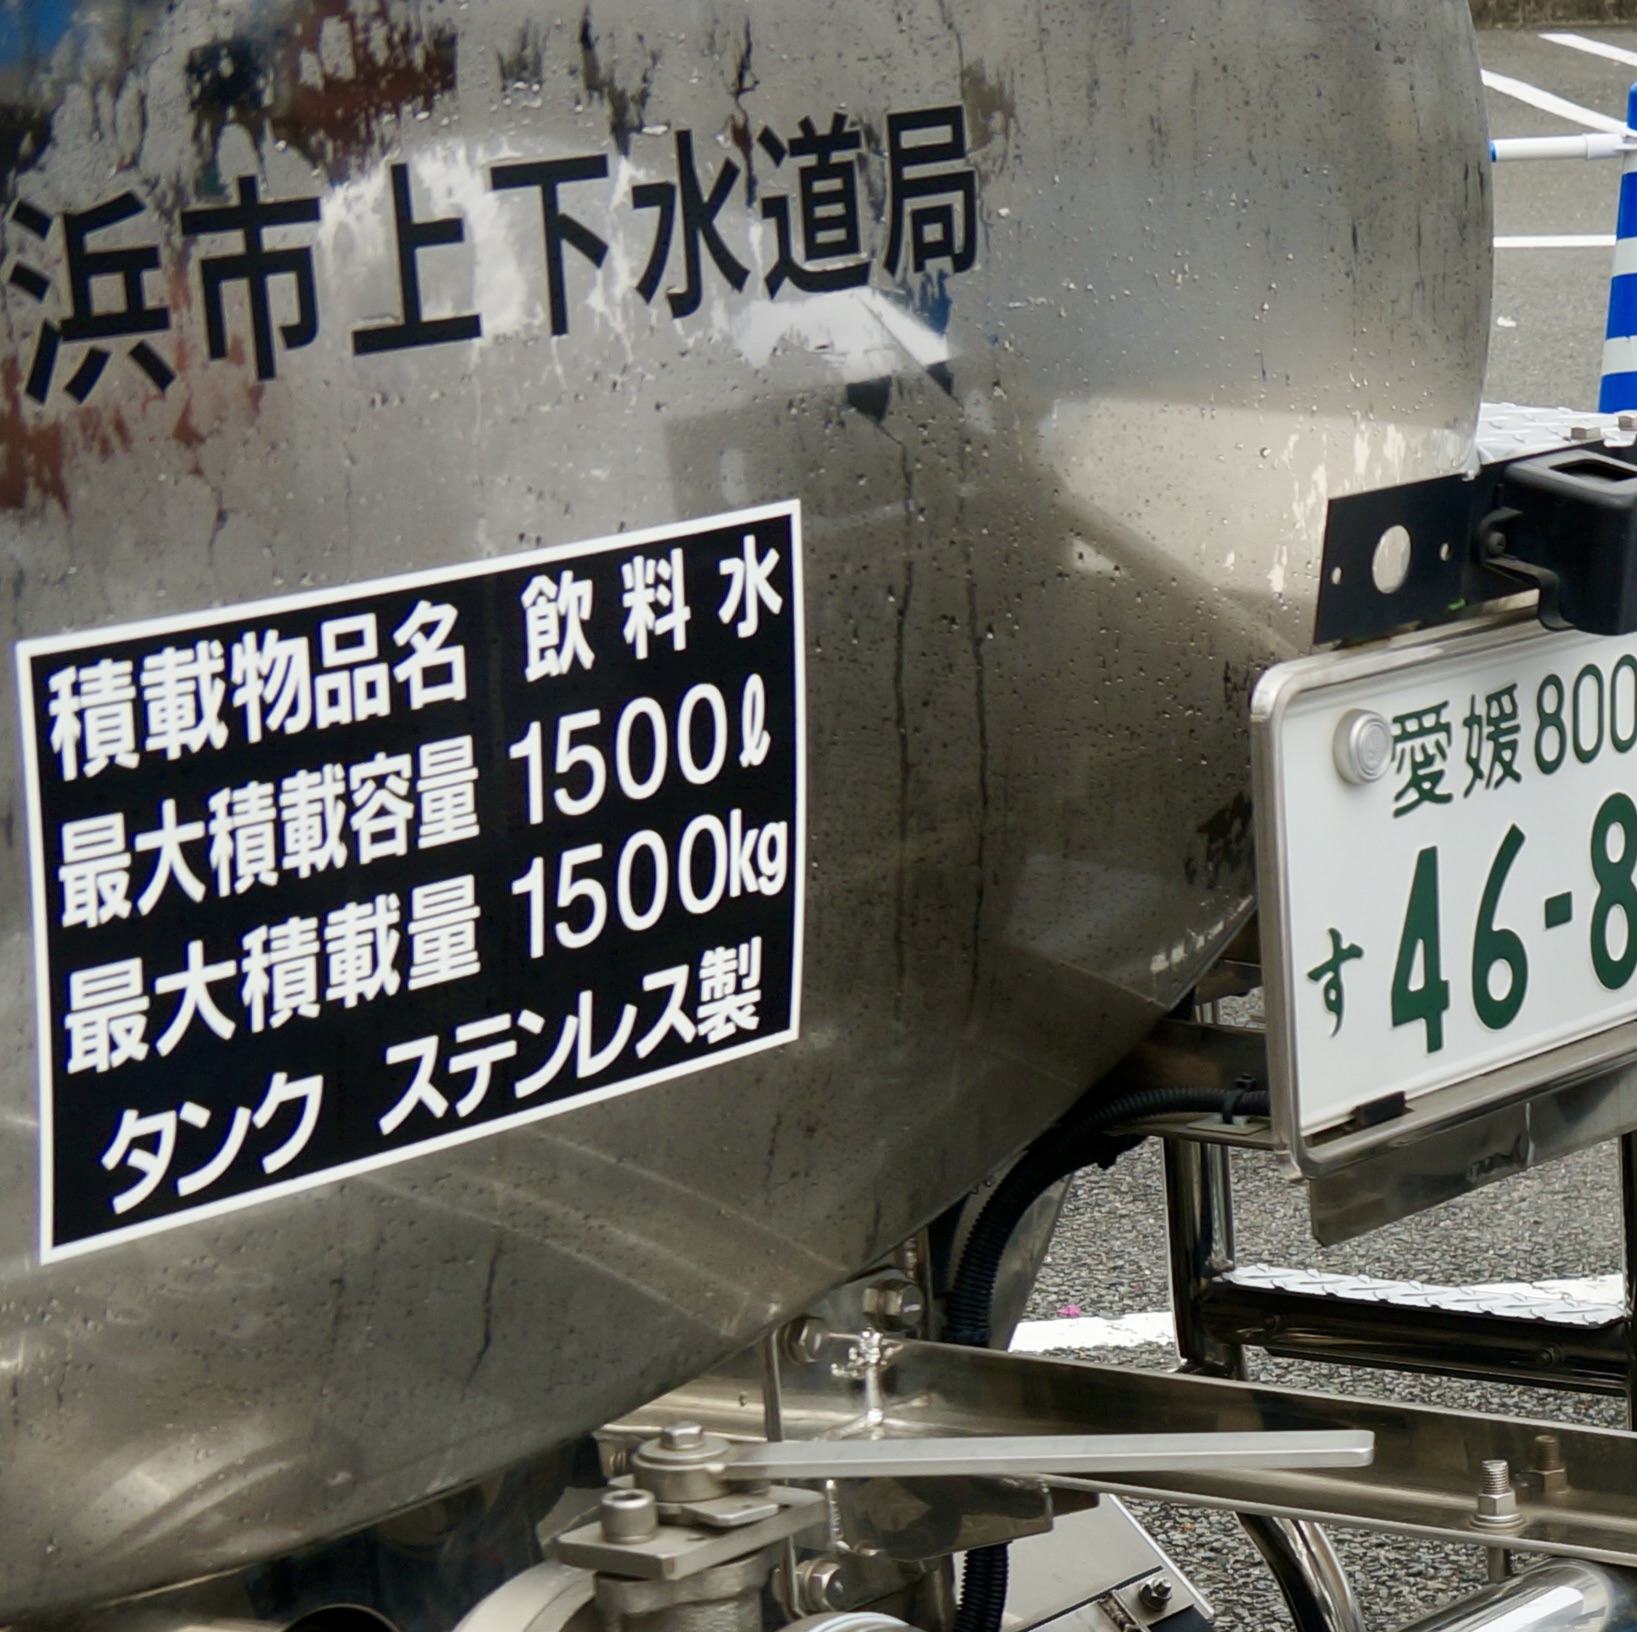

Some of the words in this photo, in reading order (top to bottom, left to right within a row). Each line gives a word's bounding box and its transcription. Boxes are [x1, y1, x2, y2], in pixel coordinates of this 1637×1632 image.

[7, 104, 979, 405] 浜市上下水道局
[48, 600, 468, 782] 積載物品名
[60, 735, 480, 929] 最大積載容量
[65, 874, 482, 1074] 最大積載量
[511, 809, 788, 959] 1500kg
[100, 1072, 324, 1214] タンク
[378, 937, 764, 1134] ステンレス製
[1307, 928, 1363, 1038] す
